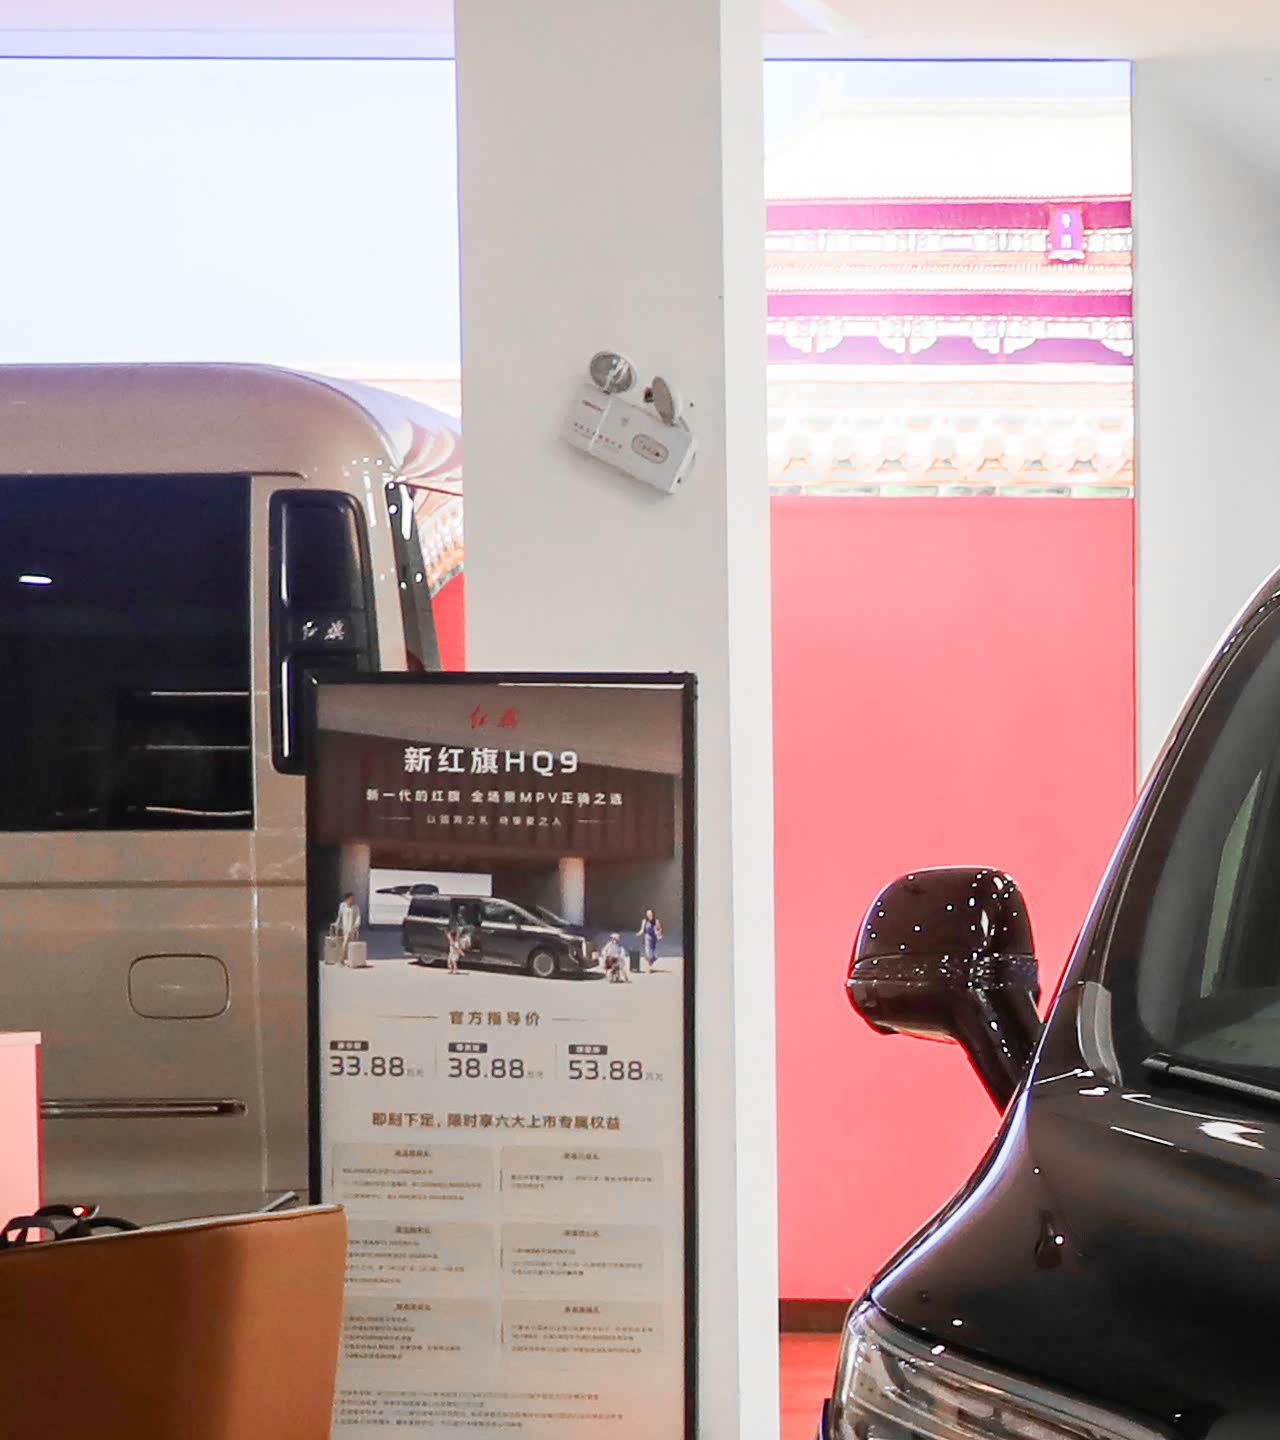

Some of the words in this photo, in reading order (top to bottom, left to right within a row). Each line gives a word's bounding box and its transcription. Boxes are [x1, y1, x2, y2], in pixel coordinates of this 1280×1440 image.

[403, 746, 579, 777] 新红旗HQ9
[449, 1010, 540, 1026] 官方指导价
[329, 1055, 404, 1077] 33.88
[448, 1057, 524, 1079] 38.88
[568, 1059, 643, 1081] 53.88
